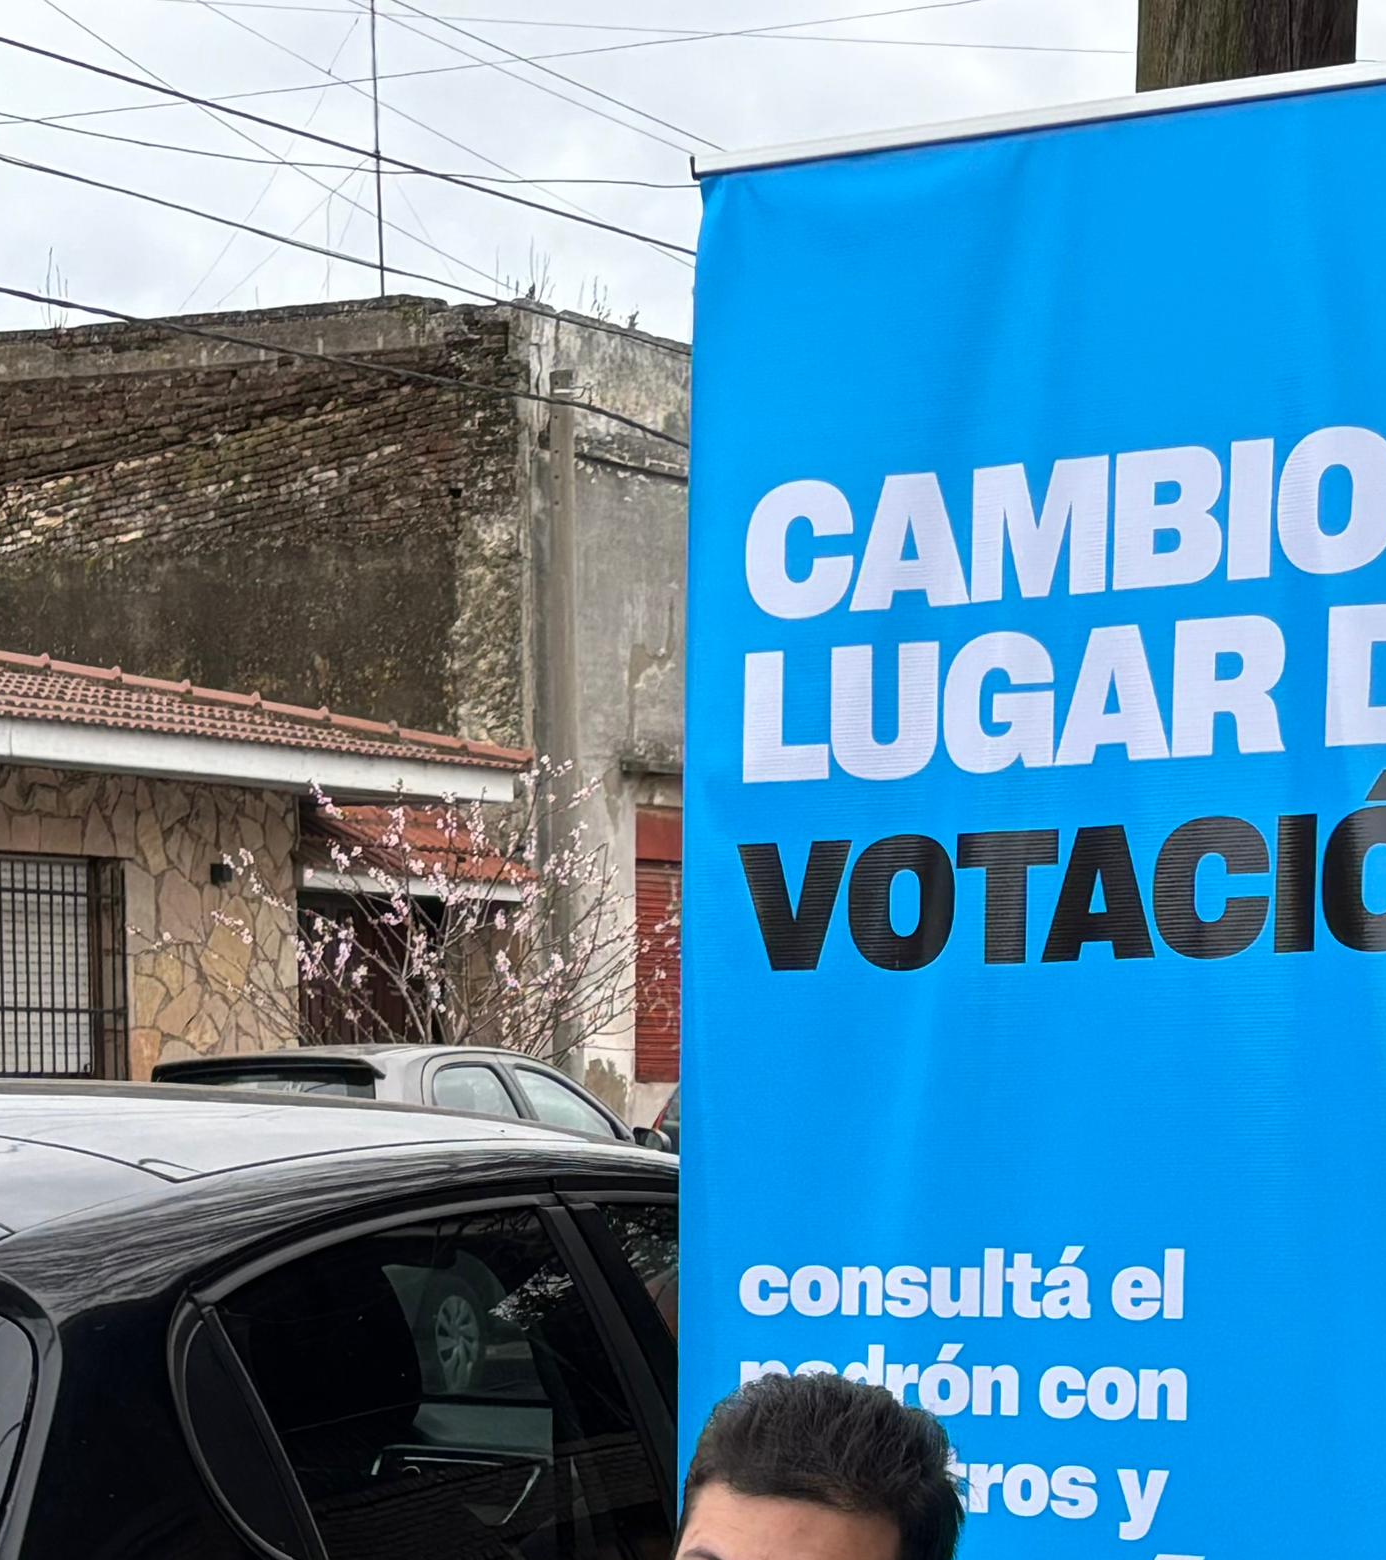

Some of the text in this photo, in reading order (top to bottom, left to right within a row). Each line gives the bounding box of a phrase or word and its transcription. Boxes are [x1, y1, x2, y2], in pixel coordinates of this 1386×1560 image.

[742, 614, 1286, 783] LUGAR
[738, 1245, 1185, 1321] consultá el
[1038, 1365, 1189, 1421] con
[1117, 1469, 1170, 1541] y
